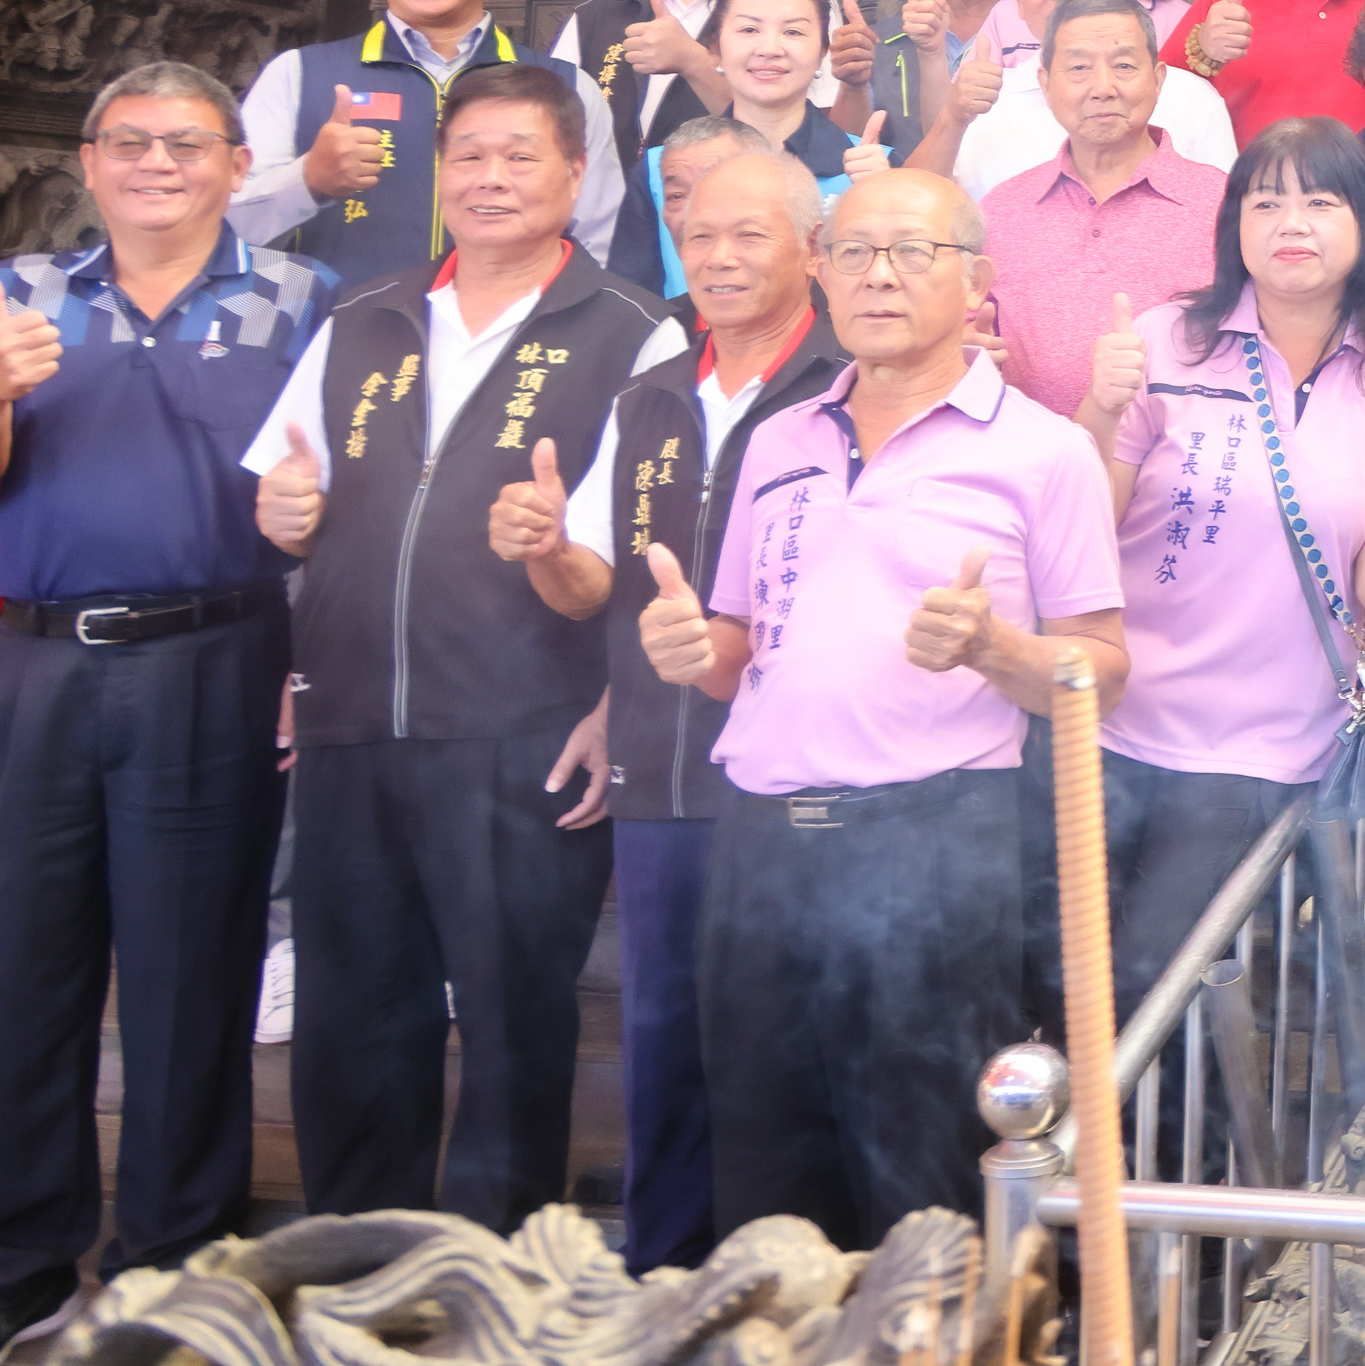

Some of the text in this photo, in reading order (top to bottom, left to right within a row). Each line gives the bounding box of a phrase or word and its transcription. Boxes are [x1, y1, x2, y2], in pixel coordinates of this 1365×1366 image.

[516, 342, 570, 364] 林口
[1202, 414, 1247, 544] 林口區瑞平里
